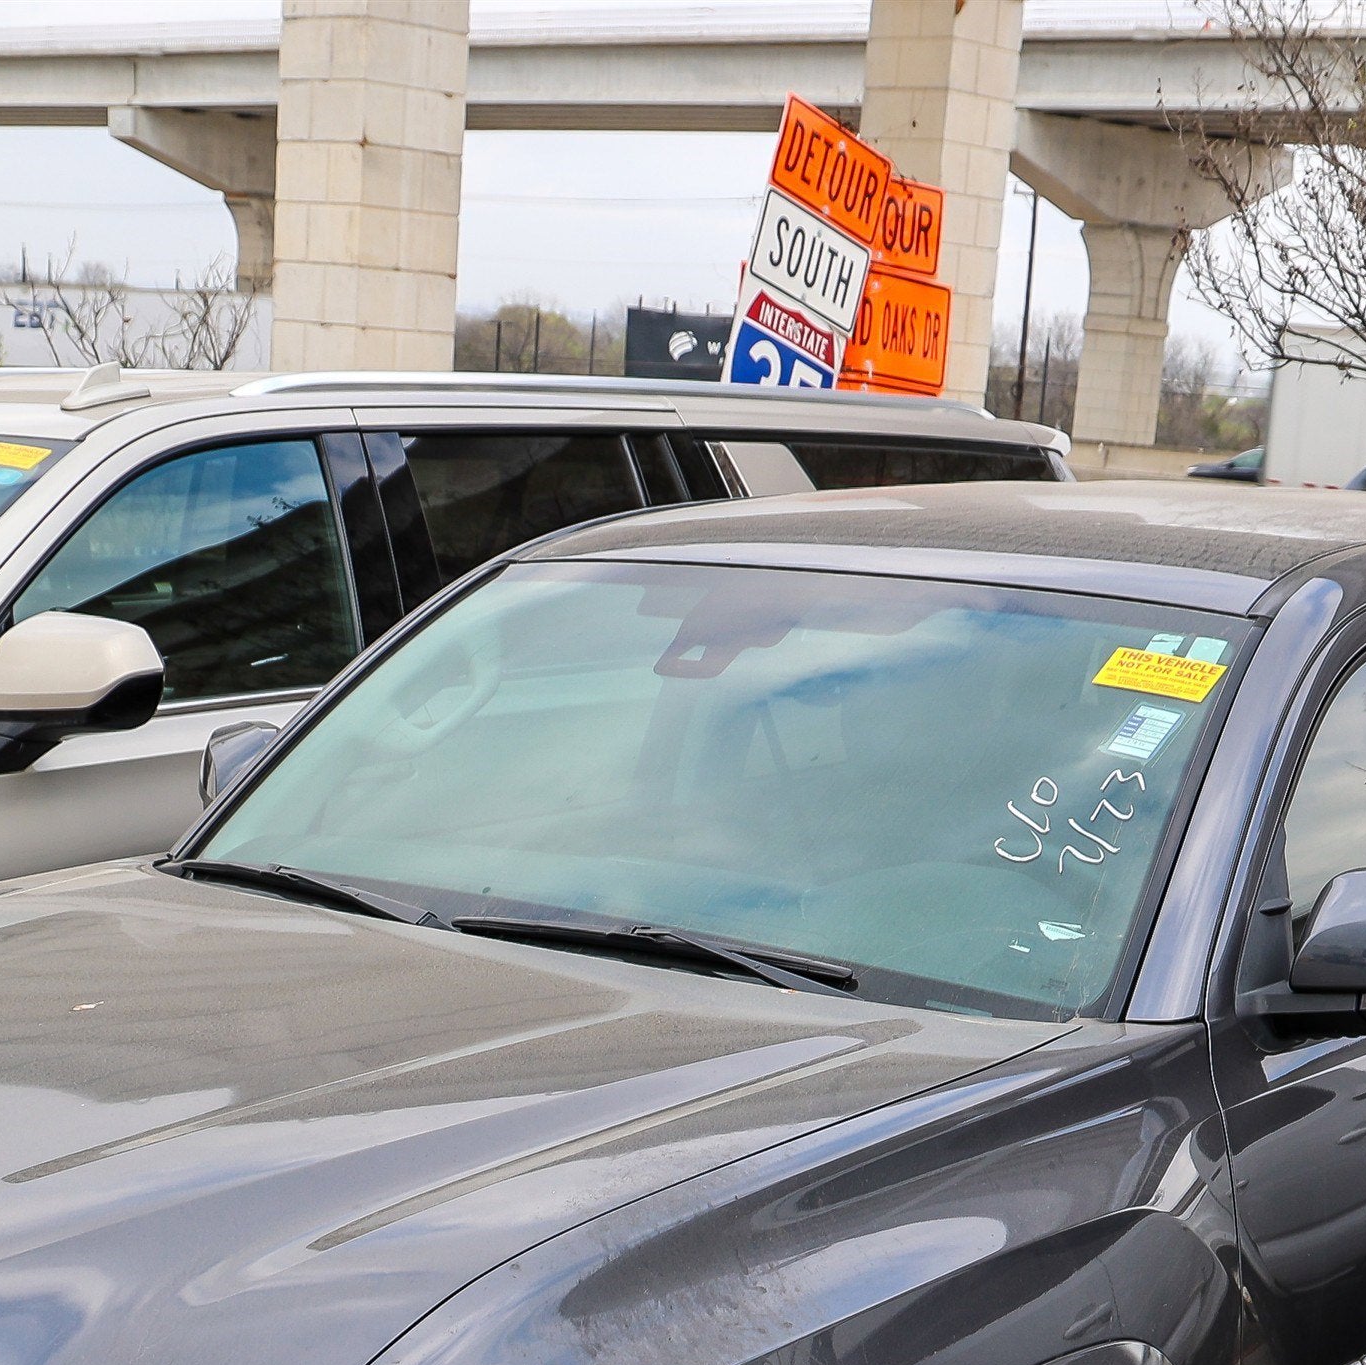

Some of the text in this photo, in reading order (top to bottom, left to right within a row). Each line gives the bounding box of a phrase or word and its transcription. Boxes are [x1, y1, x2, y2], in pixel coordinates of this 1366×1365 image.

[785, 119, 879, 226] DETOUR
[882, 195, 933, 258] OUR
[769, 214, 855, 309] SOUTH
[758, 301, 830, 361] INTERSTATE
[881, 301, 917, 355] OAKS
[922, 308, 941, 361] DR
[1116, 660, 1143, 671] NOT
[1145, 664, 1172, 675] FOR
[1175, 669, 1209, 683] SALE
[1120, 650, 1221, 676] THIS VEHICLE
